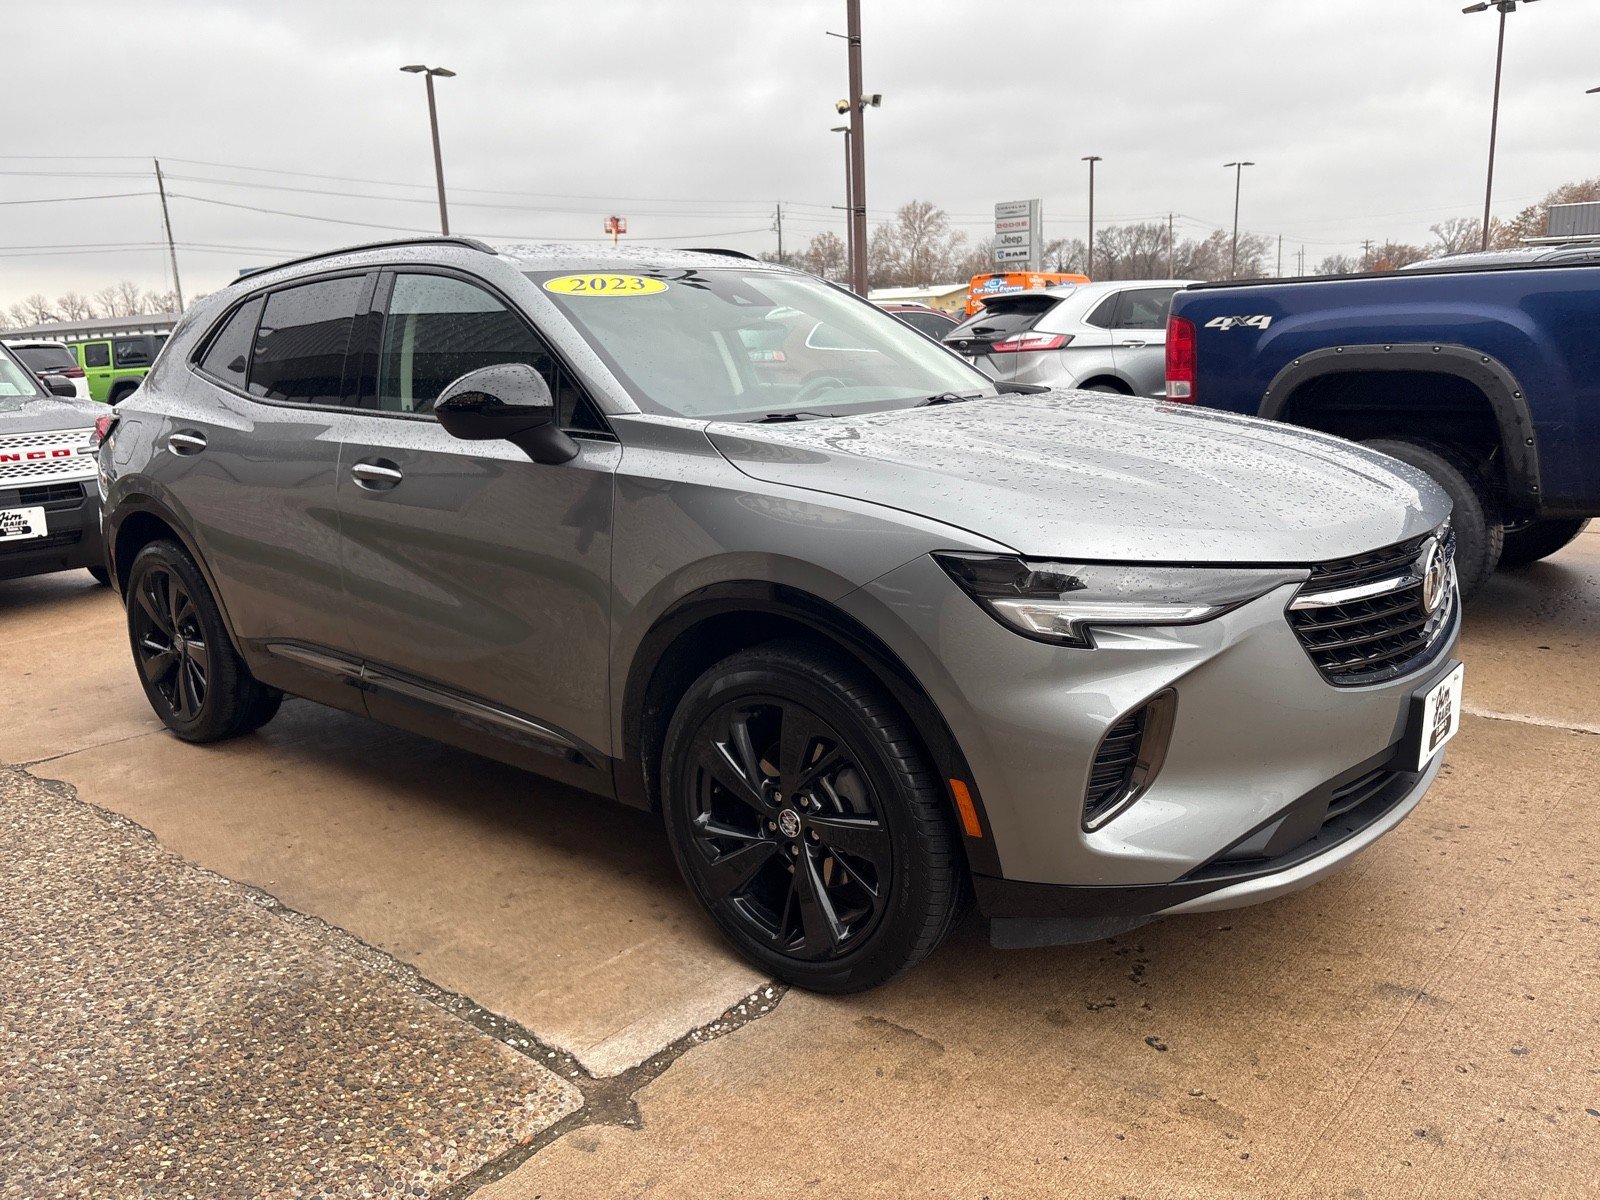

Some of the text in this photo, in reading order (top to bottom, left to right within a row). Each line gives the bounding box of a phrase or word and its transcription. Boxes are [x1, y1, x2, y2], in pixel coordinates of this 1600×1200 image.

[1001, 235, 1022, 244] Jeep
[570, 278, 645, 291] 2023
[3, 519, 29, 528] BAIER
